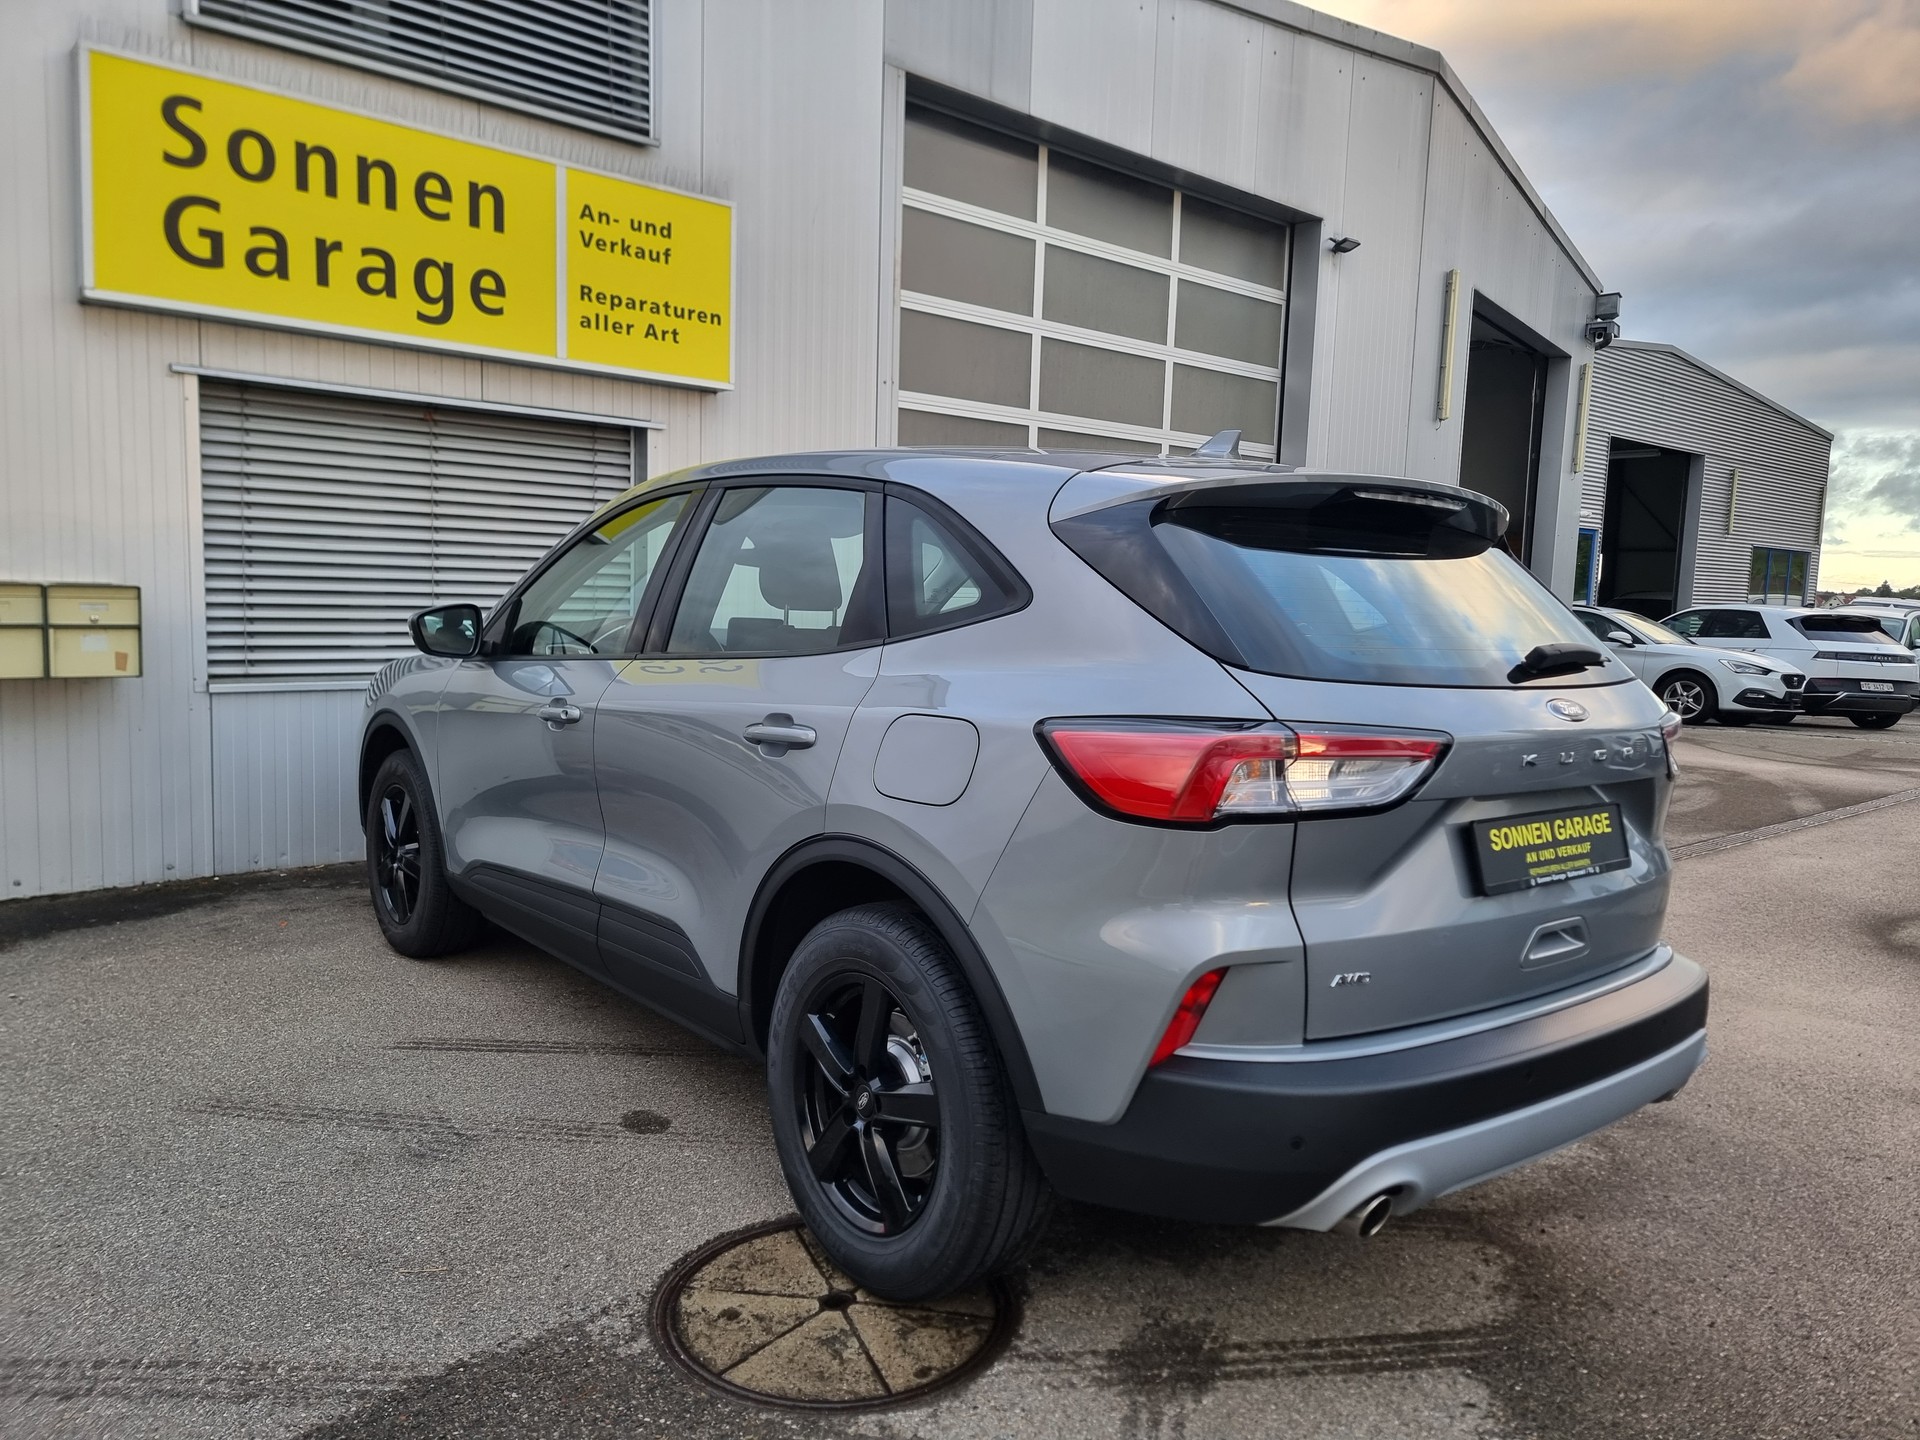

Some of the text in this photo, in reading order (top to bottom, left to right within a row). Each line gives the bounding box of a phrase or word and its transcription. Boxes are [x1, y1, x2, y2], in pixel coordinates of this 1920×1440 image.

[161, 94, 505, 234] Sonnen
[579, 203, 672, 240] An- und
[162, 195, 508, 326] Garage
[579, 230, 672, 265] Verkauf
[579, 284, 723, 327] Reparaturen
[579, 312, 680, 344] aller Art
[1559, 701, 1584, 715] Ford
[1489, 812, 1612, 852] SONNEN GARAGE
[1526, 842, 1592, 864] AN UND VERKAUF
